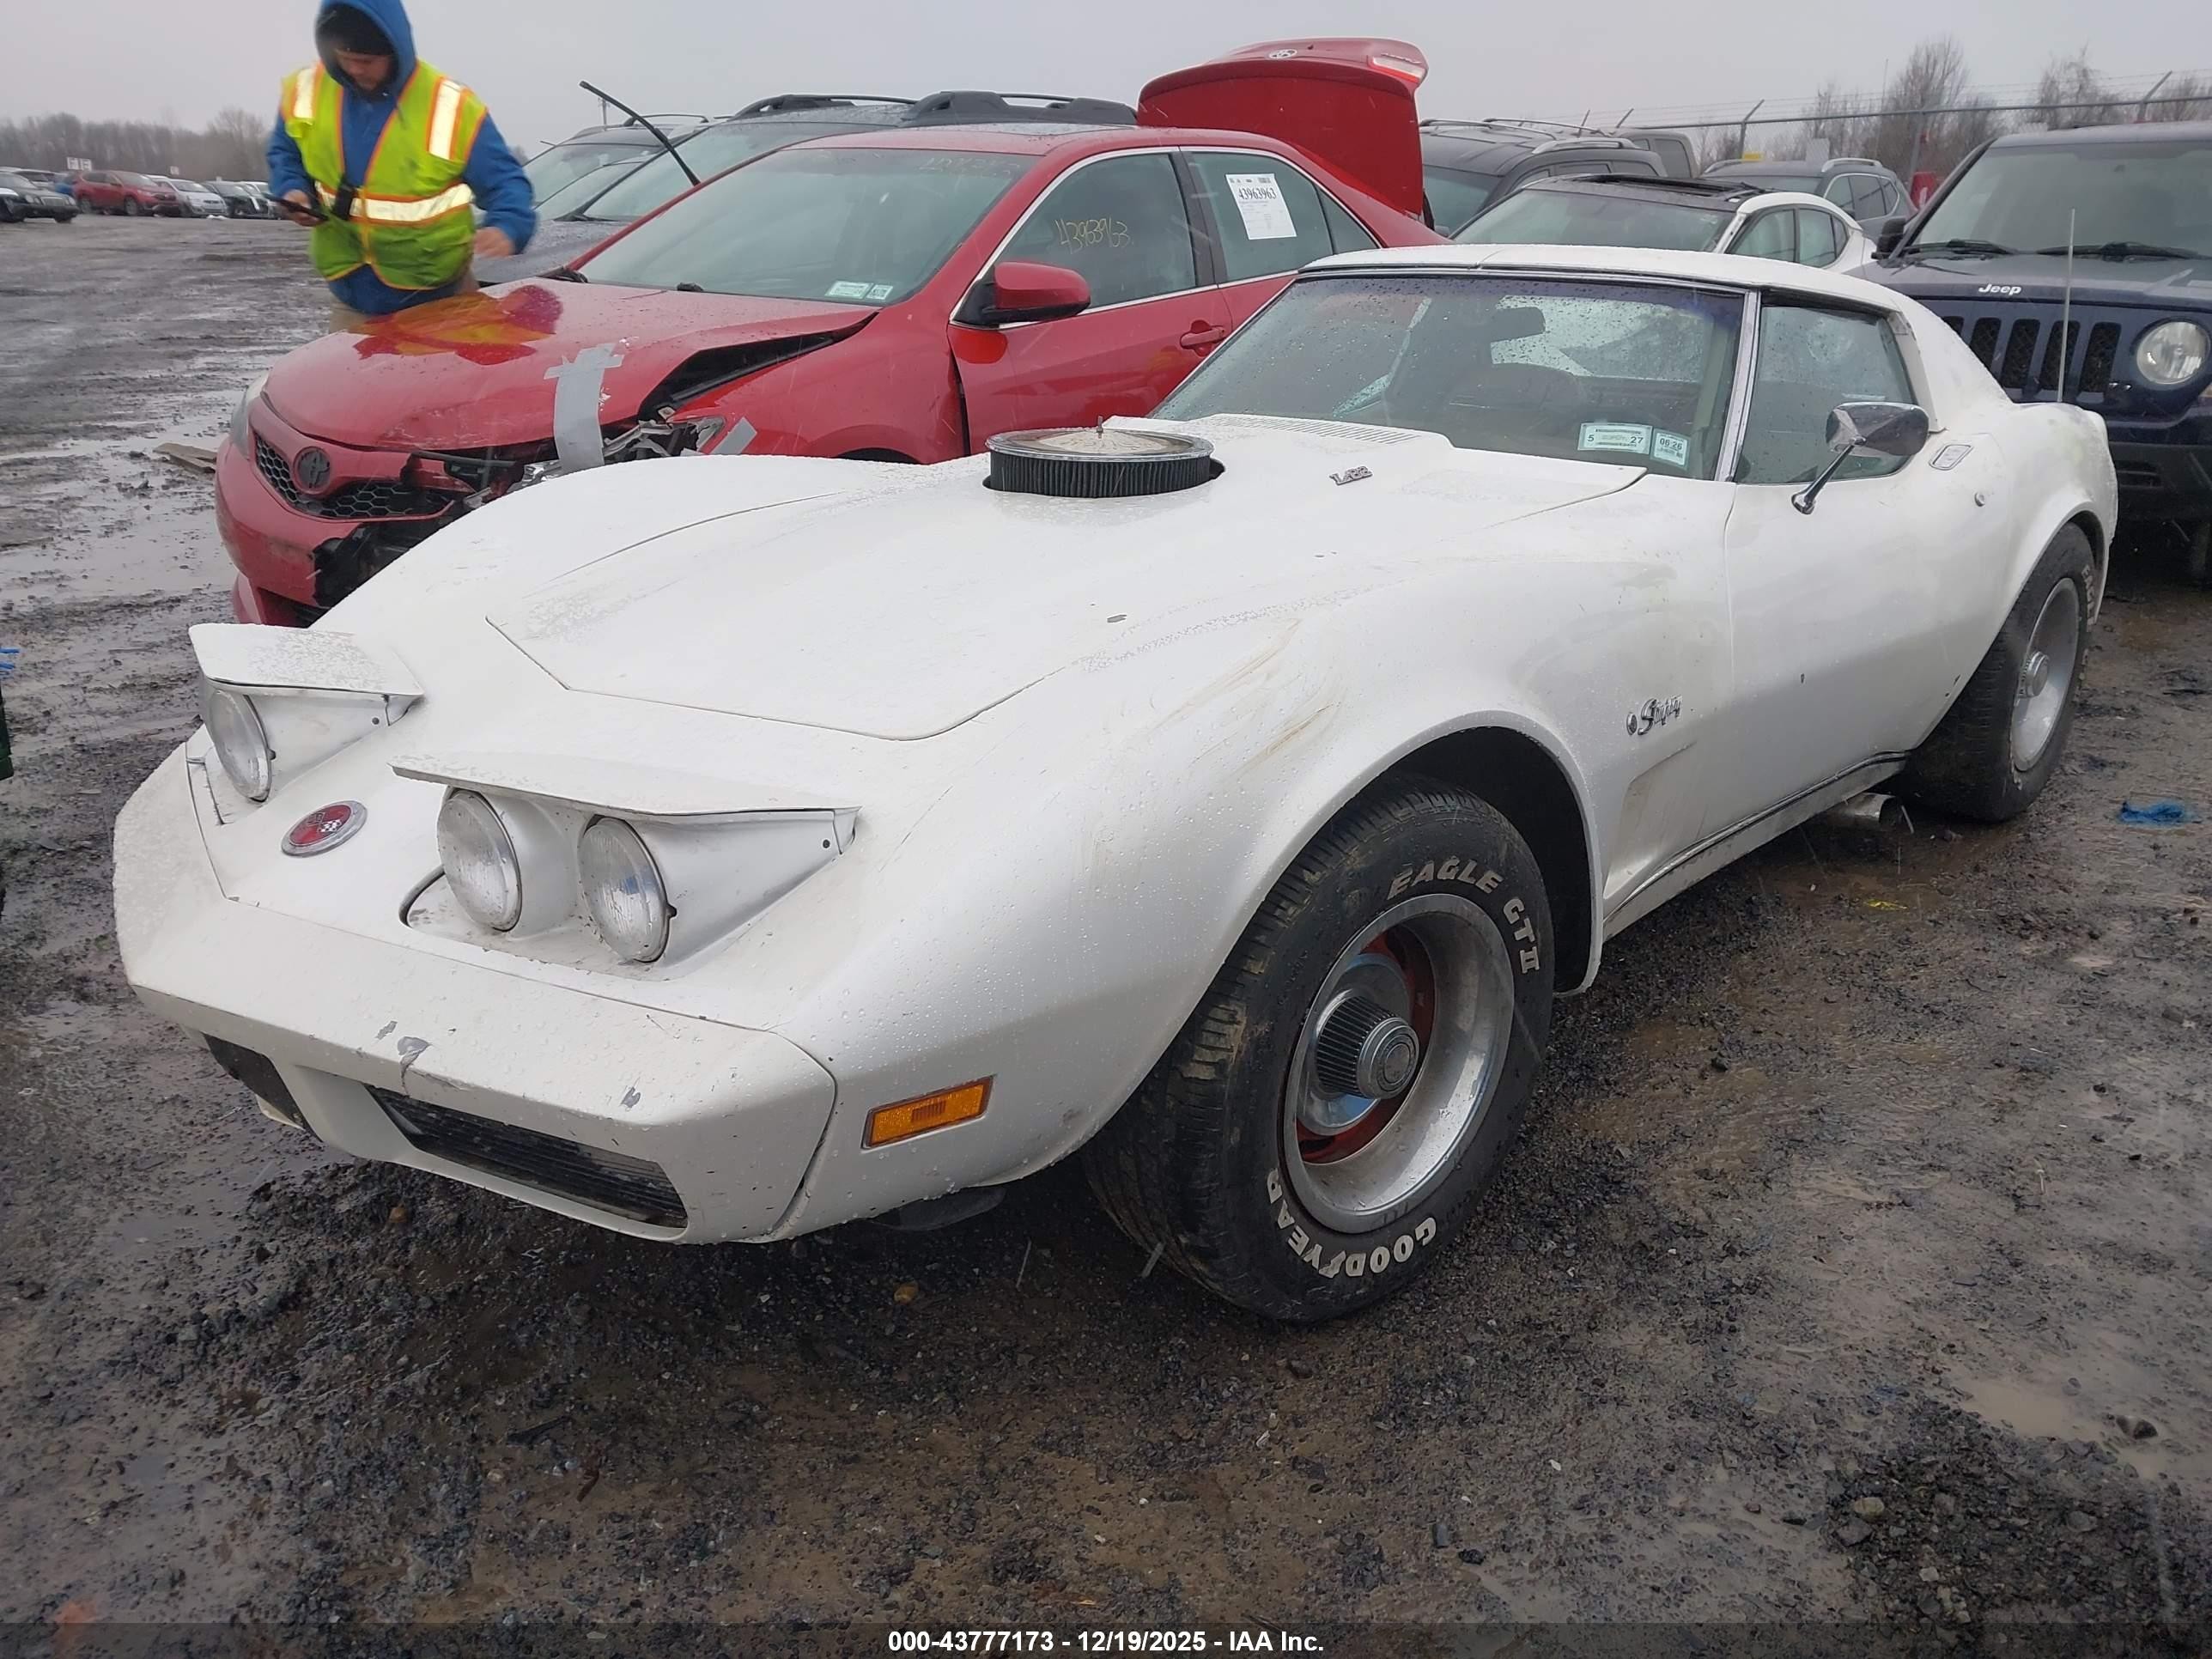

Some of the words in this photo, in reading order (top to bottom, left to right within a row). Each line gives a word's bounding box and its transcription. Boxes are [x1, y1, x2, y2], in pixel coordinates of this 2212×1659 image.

[1238, 187, 1277, 200] 43963963
[1054, 216, 1131, 254] 43963963
[1978, 283, 2022, 296] Jeep
[1587, 434, 1595, 442] 5
[1630, 435, 1644, 445] 27
[1386, 856, 1504, 901] EAGLE
[1267, 1167, 1437, 1279] GOODYEAR
